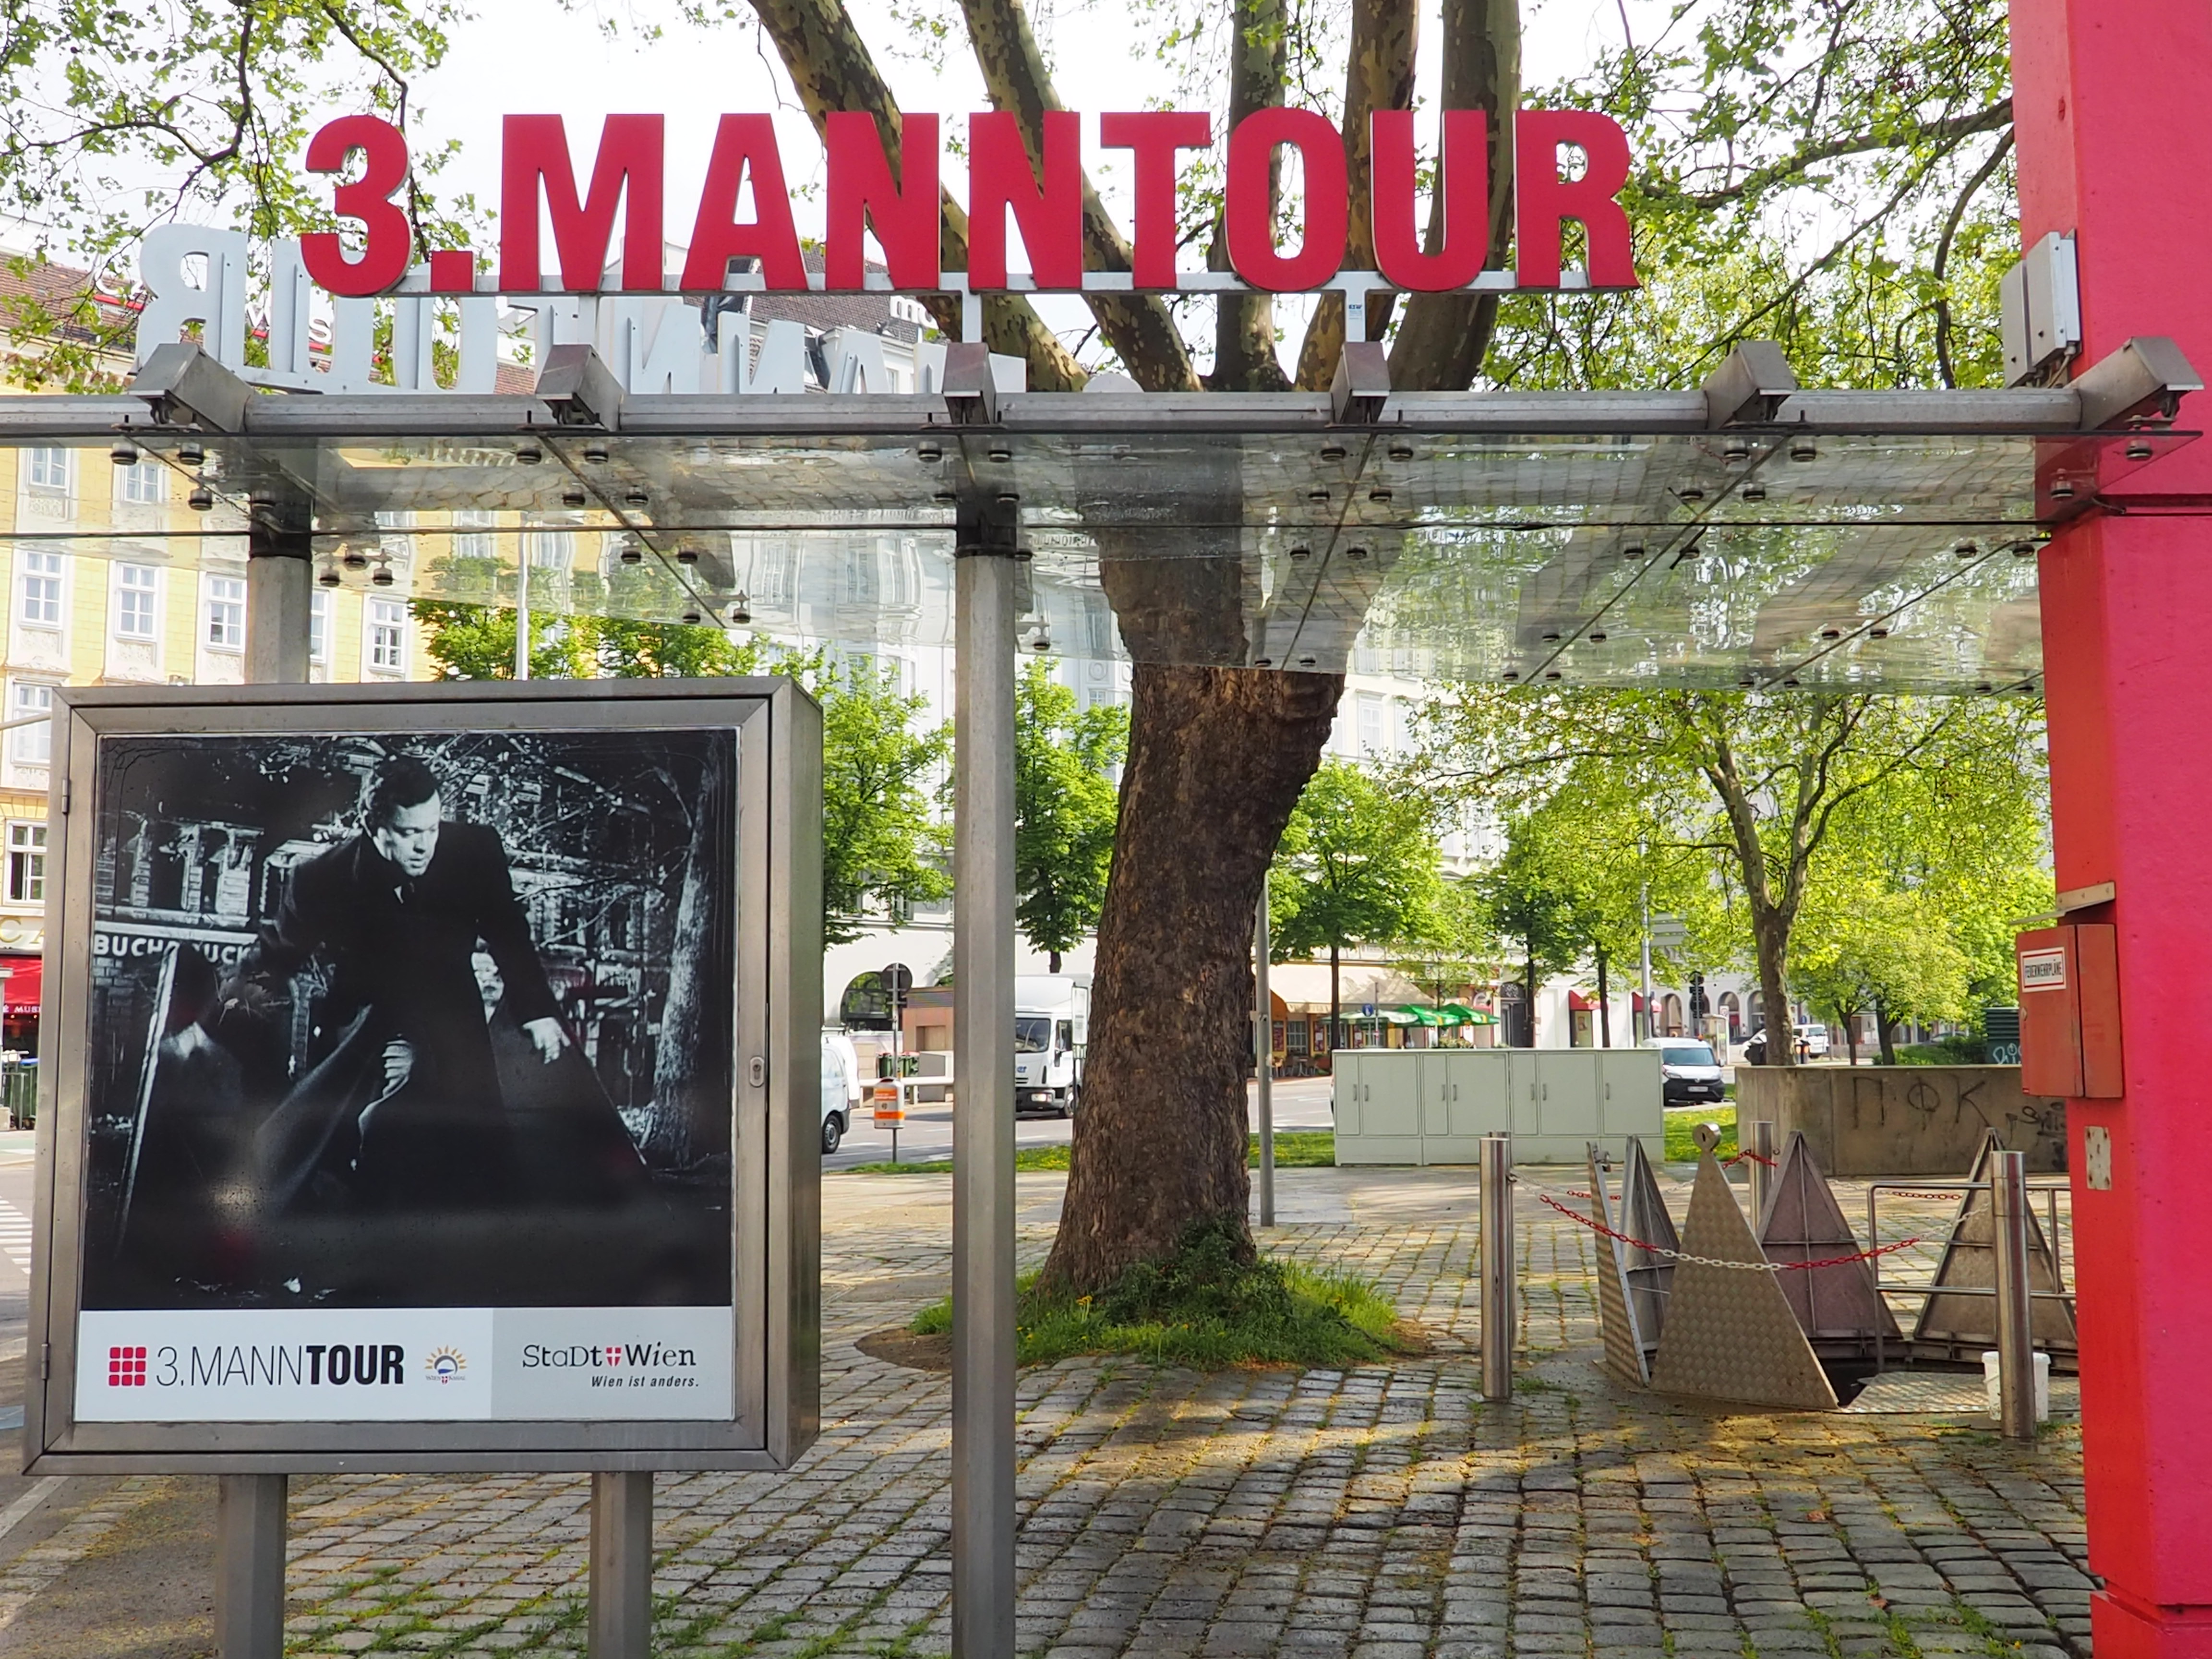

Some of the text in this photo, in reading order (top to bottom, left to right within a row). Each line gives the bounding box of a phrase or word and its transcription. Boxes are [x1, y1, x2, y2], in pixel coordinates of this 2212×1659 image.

[625, 1342, 697, 1367] Wien
[591, 1376, 699, 1388] Wien ist anders.
